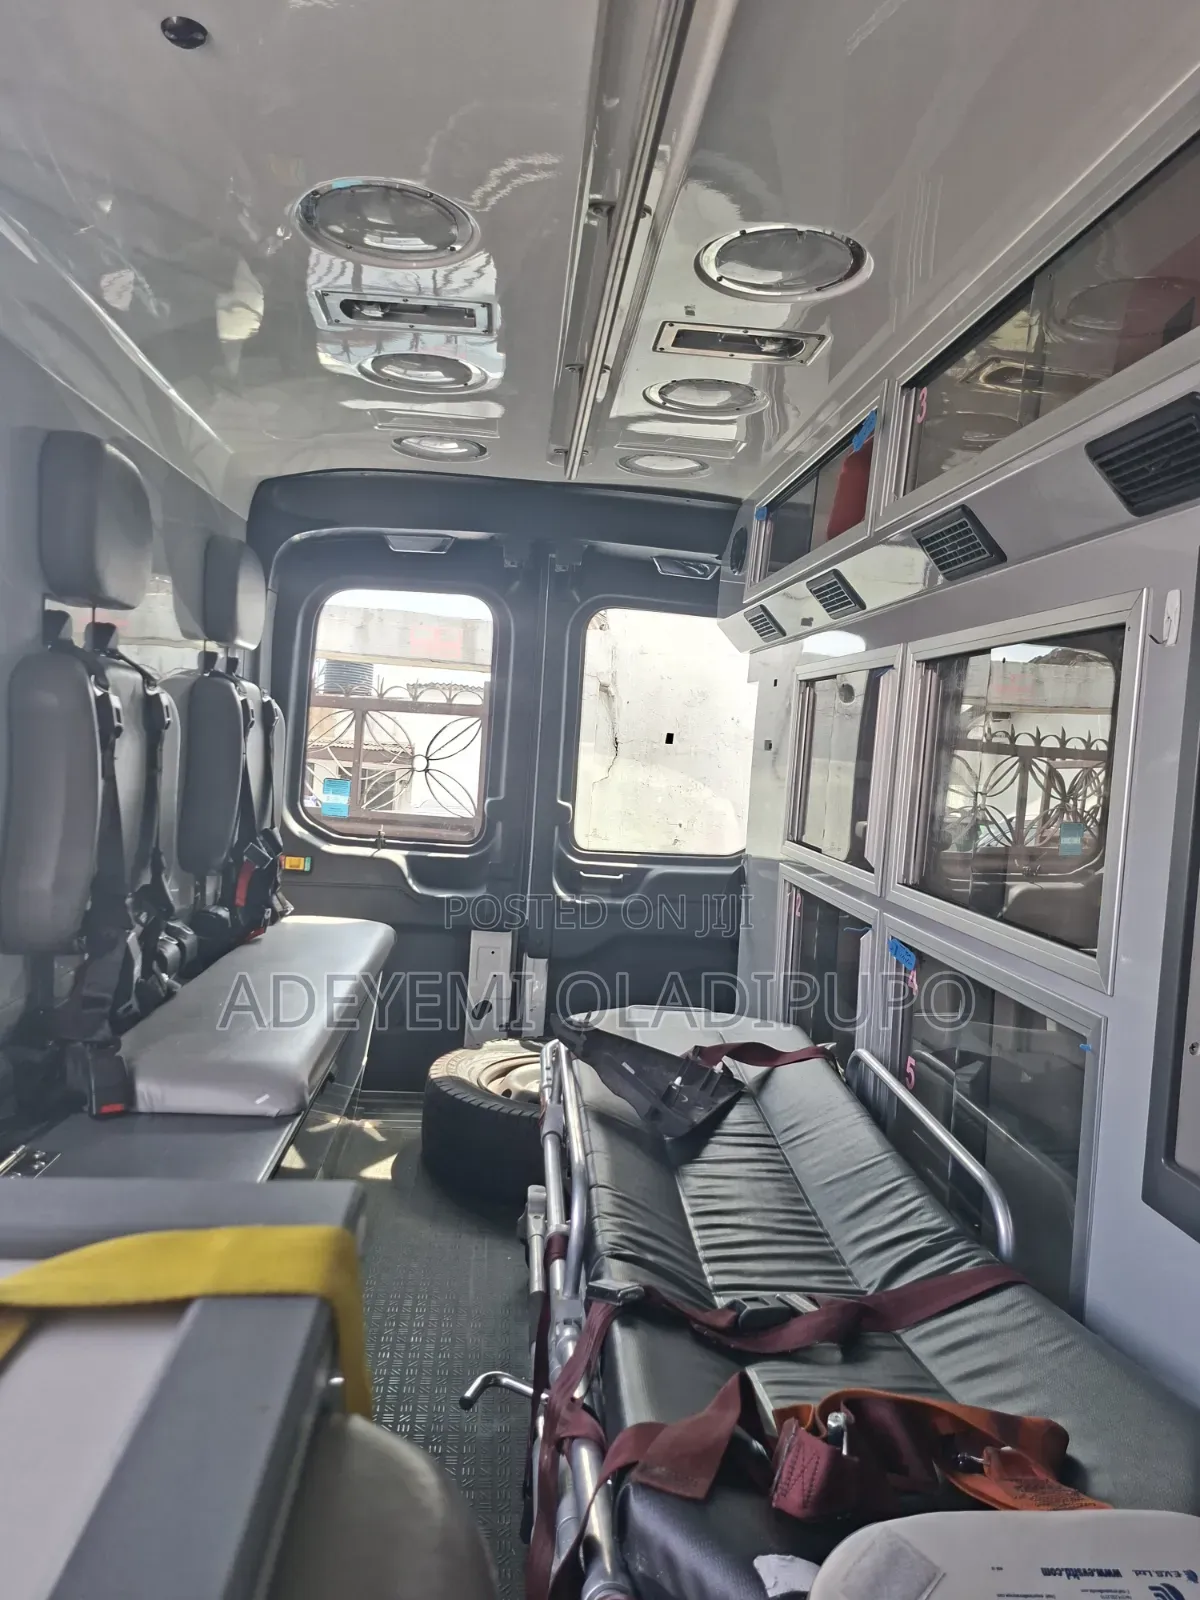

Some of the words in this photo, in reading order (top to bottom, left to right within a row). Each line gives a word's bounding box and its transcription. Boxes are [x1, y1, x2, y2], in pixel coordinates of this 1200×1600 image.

[916, 387, 928, 424] 3
[905, 1056, 916, 1090] 5
[1040, 1566, 1123, 1580] www.evsltd.com
